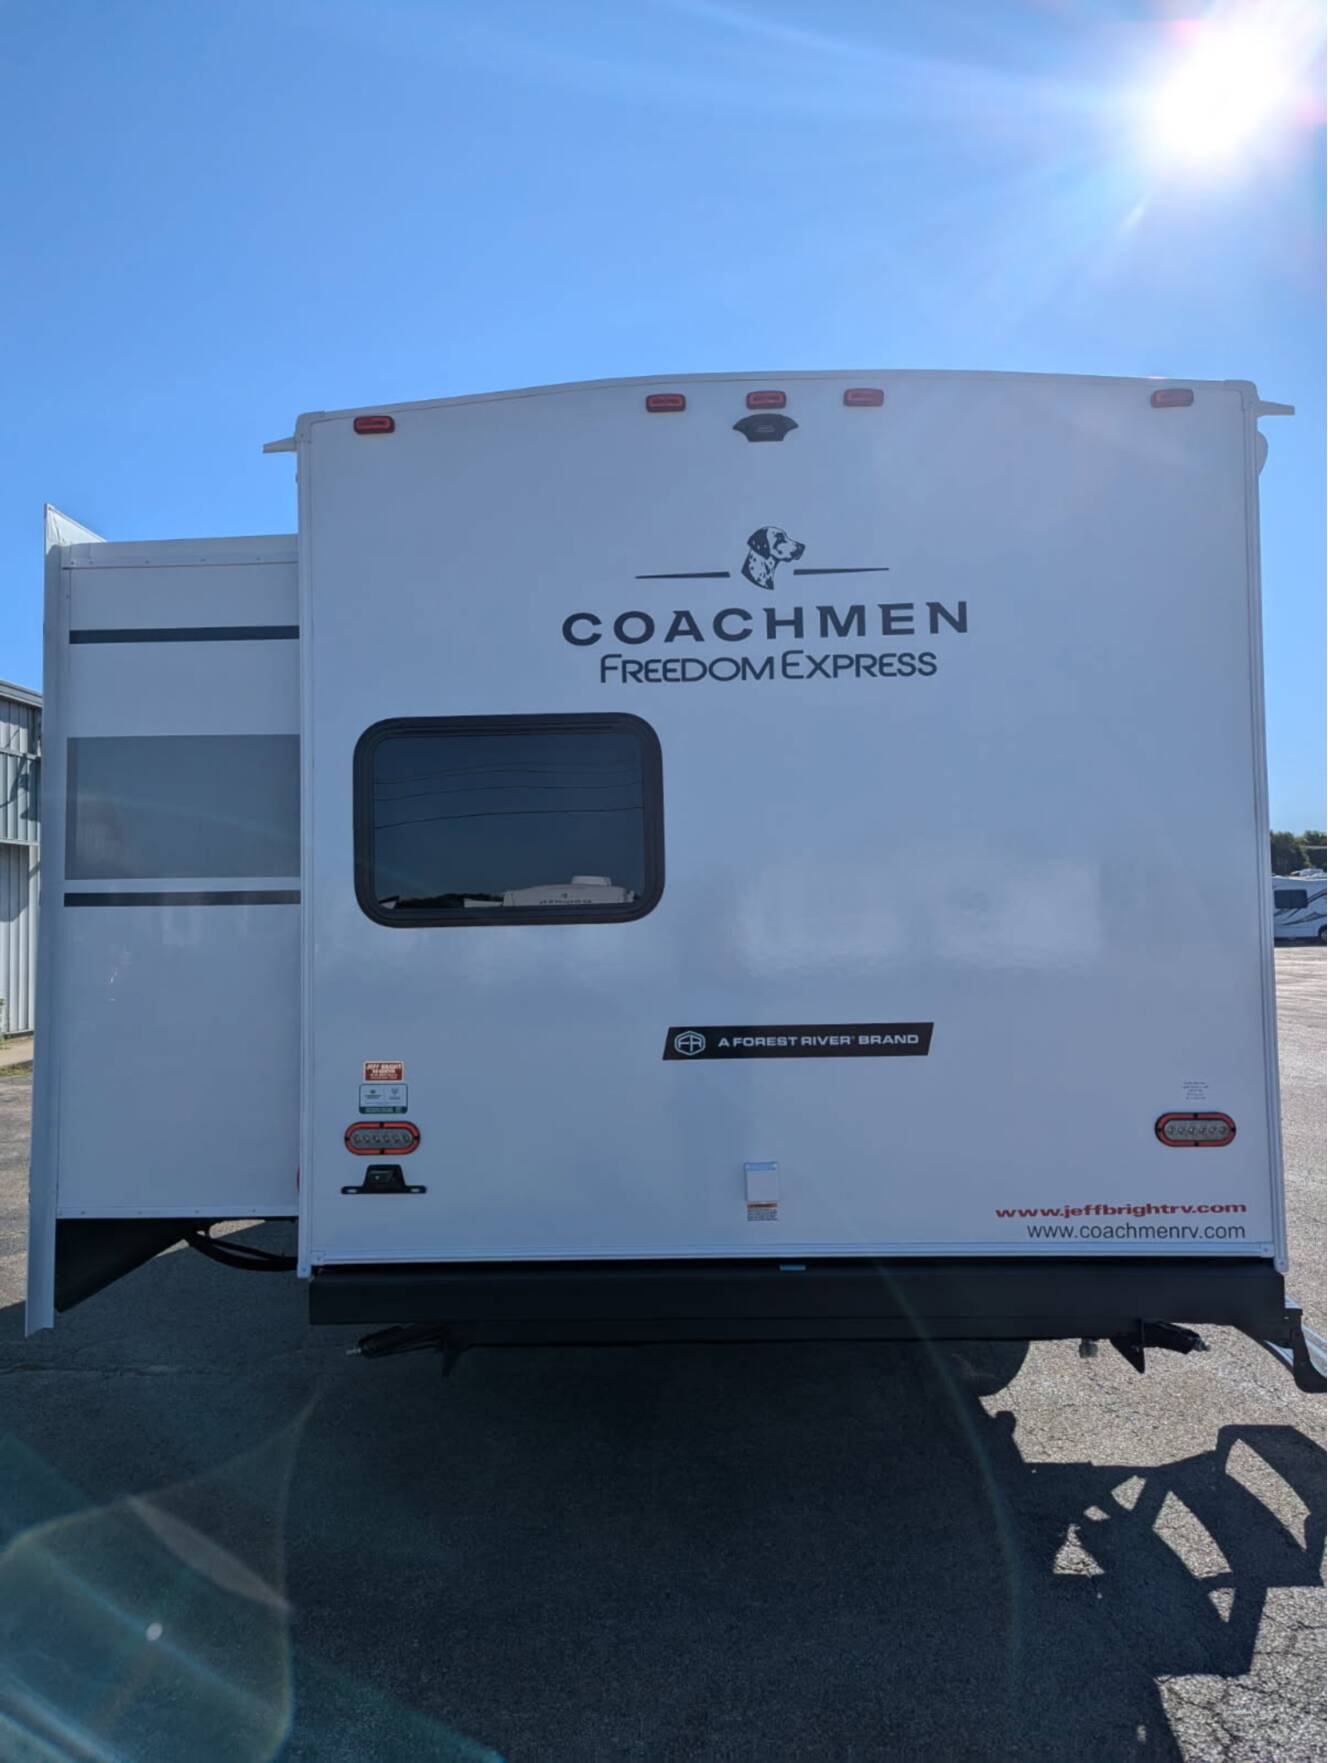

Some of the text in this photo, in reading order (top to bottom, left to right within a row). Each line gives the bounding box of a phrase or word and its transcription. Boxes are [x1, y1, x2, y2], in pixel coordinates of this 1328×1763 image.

[562, 601, 968, 646] COACHMEN
[718, 1034, 919, 1047] A FOREST RIVER BRAND
[995, 1203, 1247, 1219] www.jeffbrightrv.com
[1027, 1222, 1246, 1240] www.coachmenrv.com
